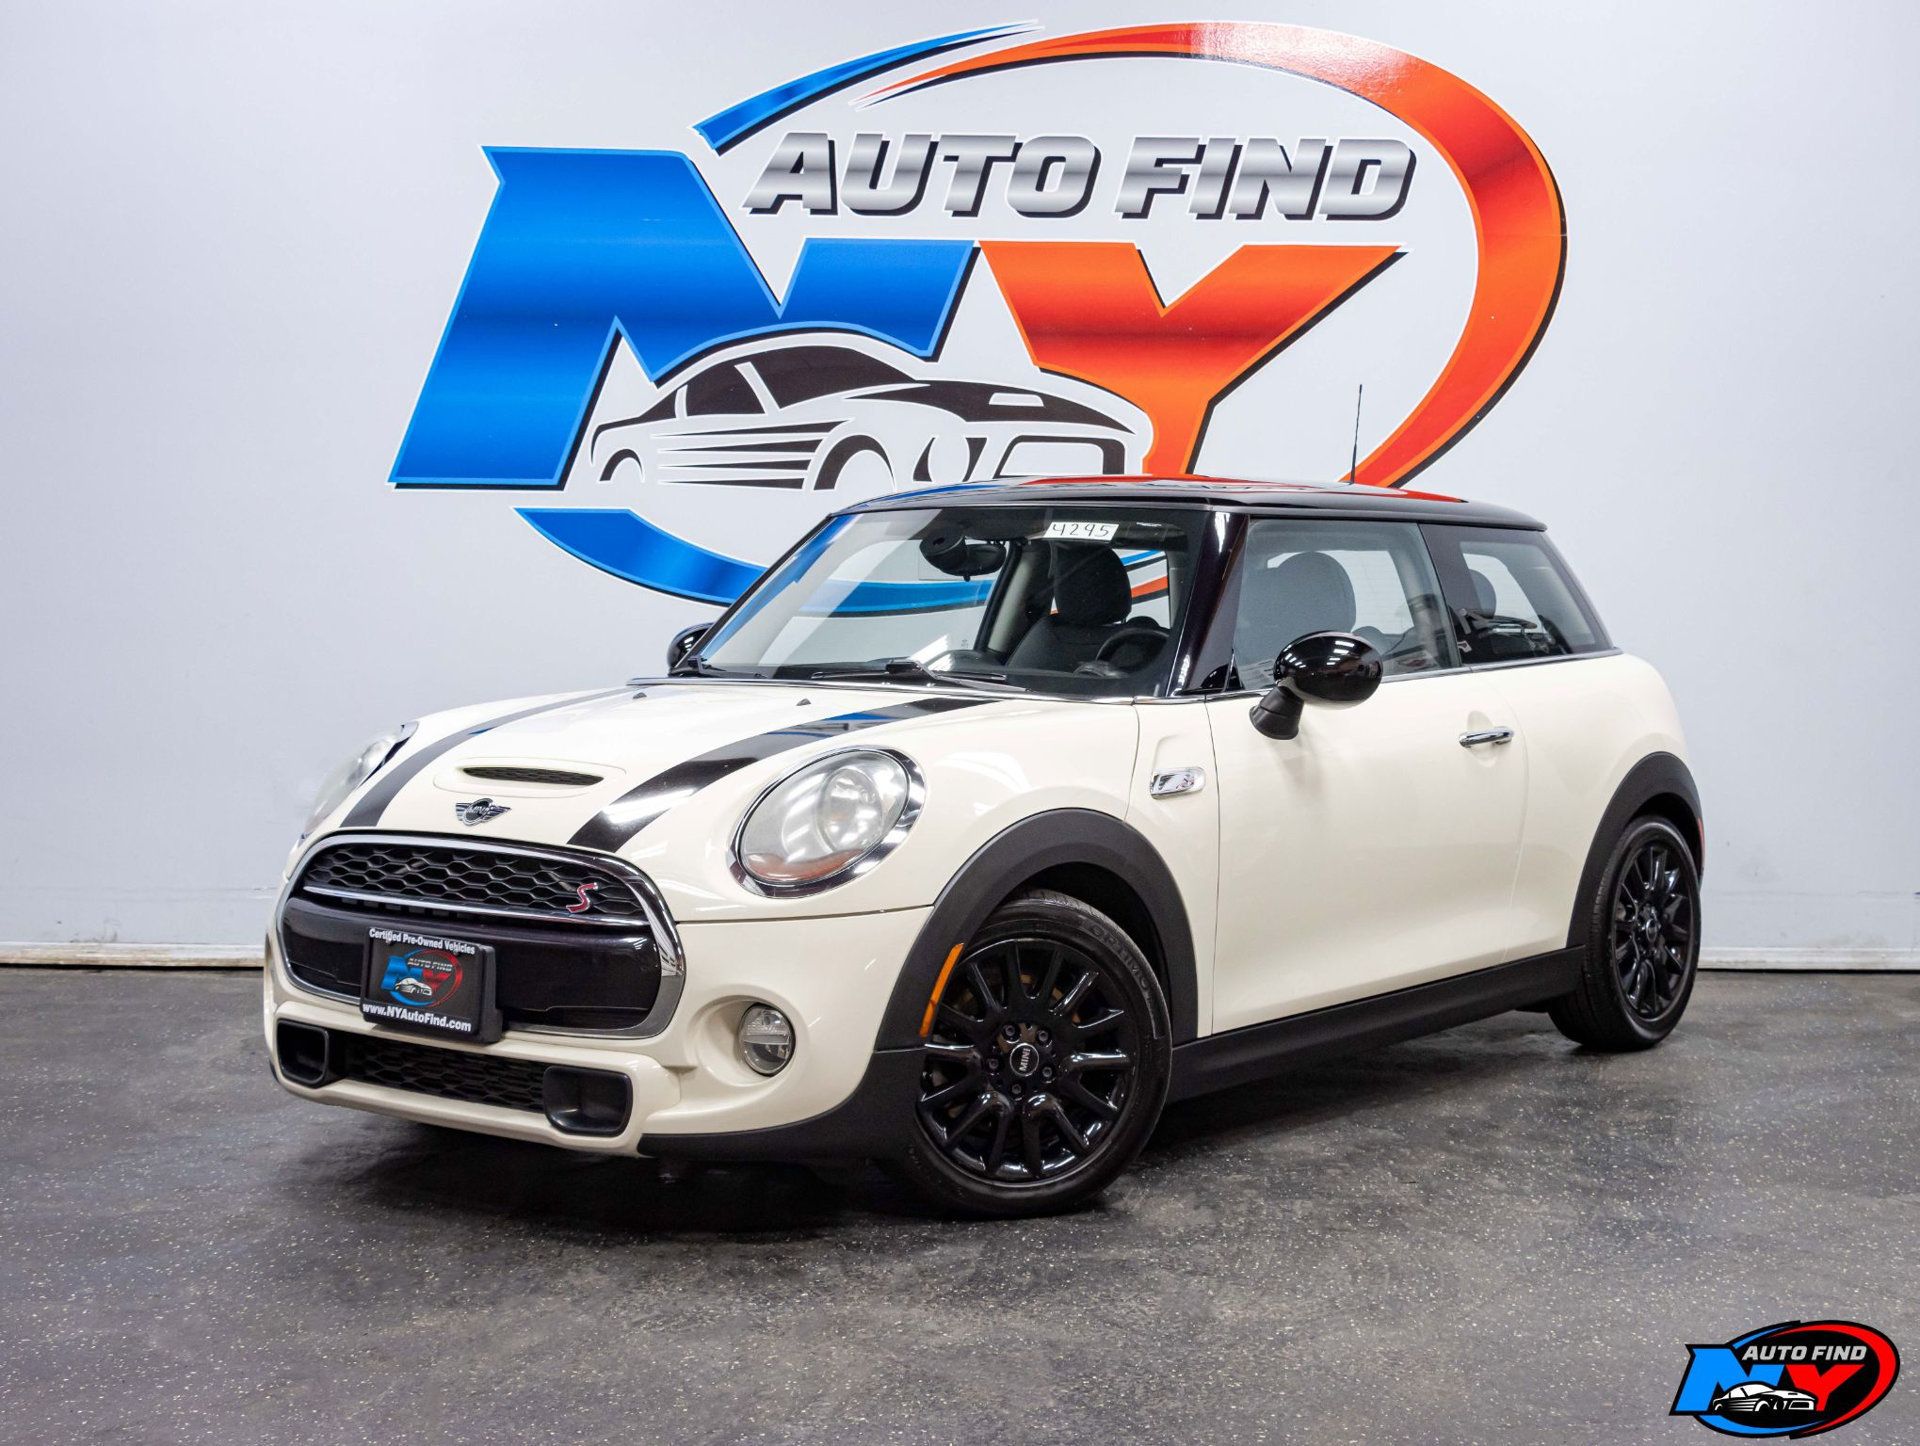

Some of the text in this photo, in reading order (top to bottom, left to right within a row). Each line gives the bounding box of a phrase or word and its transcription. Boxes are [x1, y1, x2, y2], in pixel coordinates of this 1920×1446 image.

[742, 132, 1417, 221] AUTO FIND
[566, 882, 598, 913] S
[369, 928, 476, 955] Certified Pre-Owned Vehicles
[362, 1003, 472, 1032] www.NYAutoFind.com
[1018, 1047, 1031, 1072] MINI
